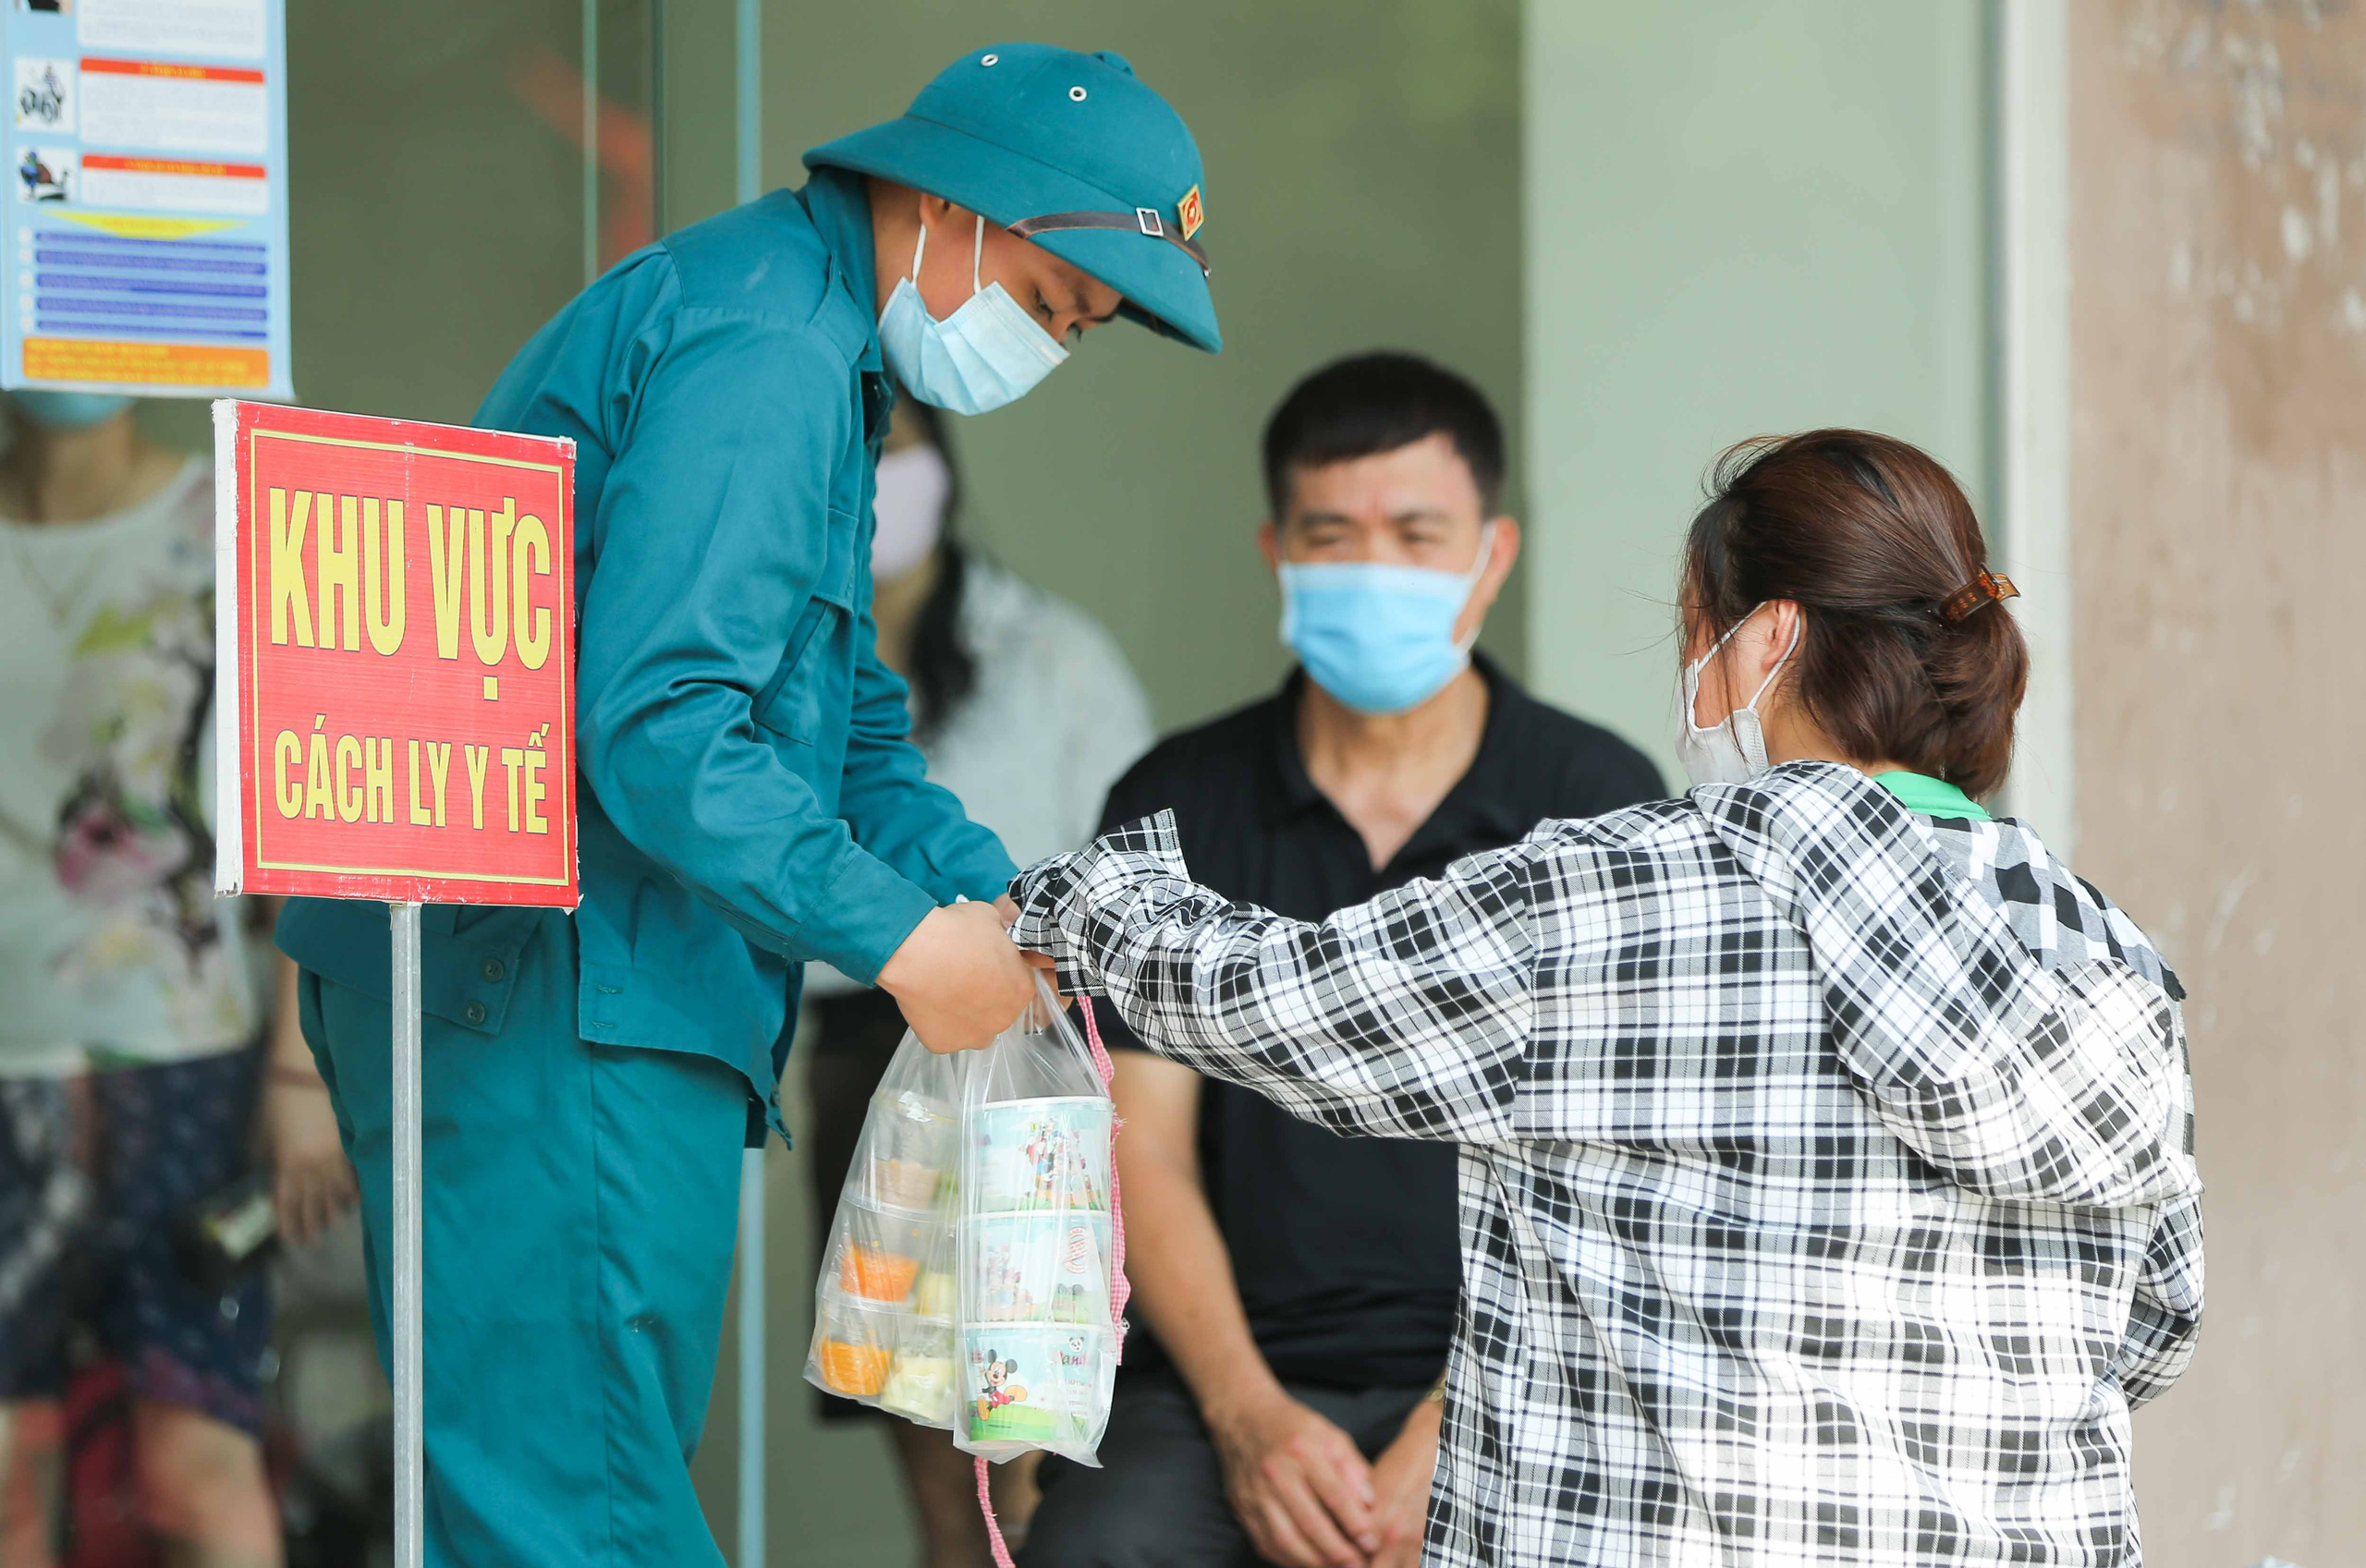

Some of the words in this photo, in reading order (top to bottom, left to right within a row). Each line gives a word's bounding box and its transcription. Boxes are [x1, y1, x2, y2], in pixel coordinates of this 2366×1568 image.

[269, 487, 407, 656] KHU
[426, 496, 552, 700] VỰC
[274, 714, 394, 823] CÁCH
[409, 738, 452, 828] LY
[465, 743, 490, 830] Y
[500, 723, 550, 834] TẾ
